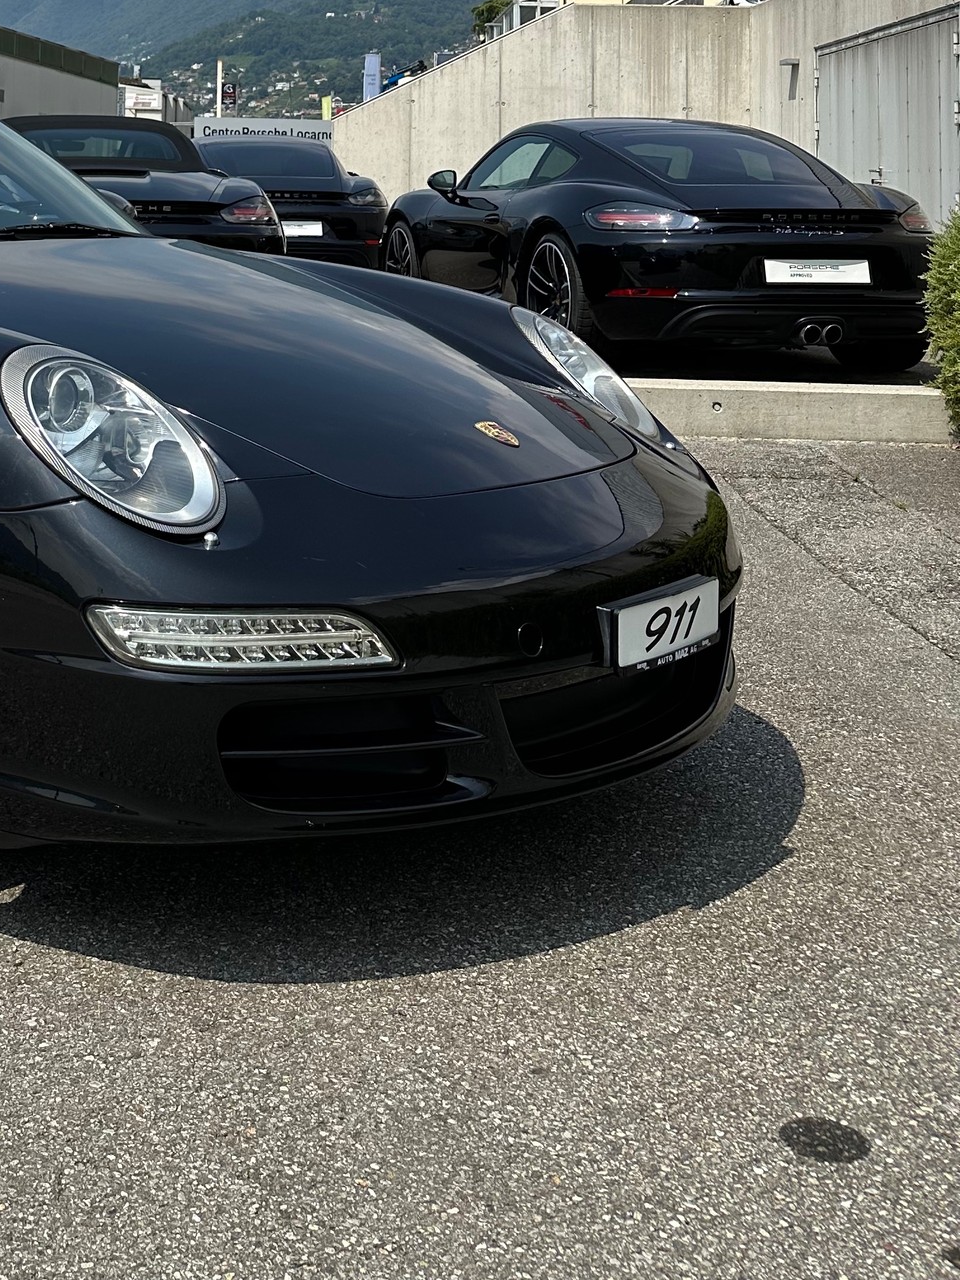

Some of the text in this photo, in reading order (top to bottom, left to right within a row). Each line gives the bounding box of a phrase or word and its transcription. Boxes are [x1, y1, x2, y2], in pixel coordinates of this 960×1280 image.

[762, 213, 860, 221] PORSCHE
[645, 595, 701, 653] 911
[657, 654, 673, 665] AUTO
[690, 644, 698, 653] AG
